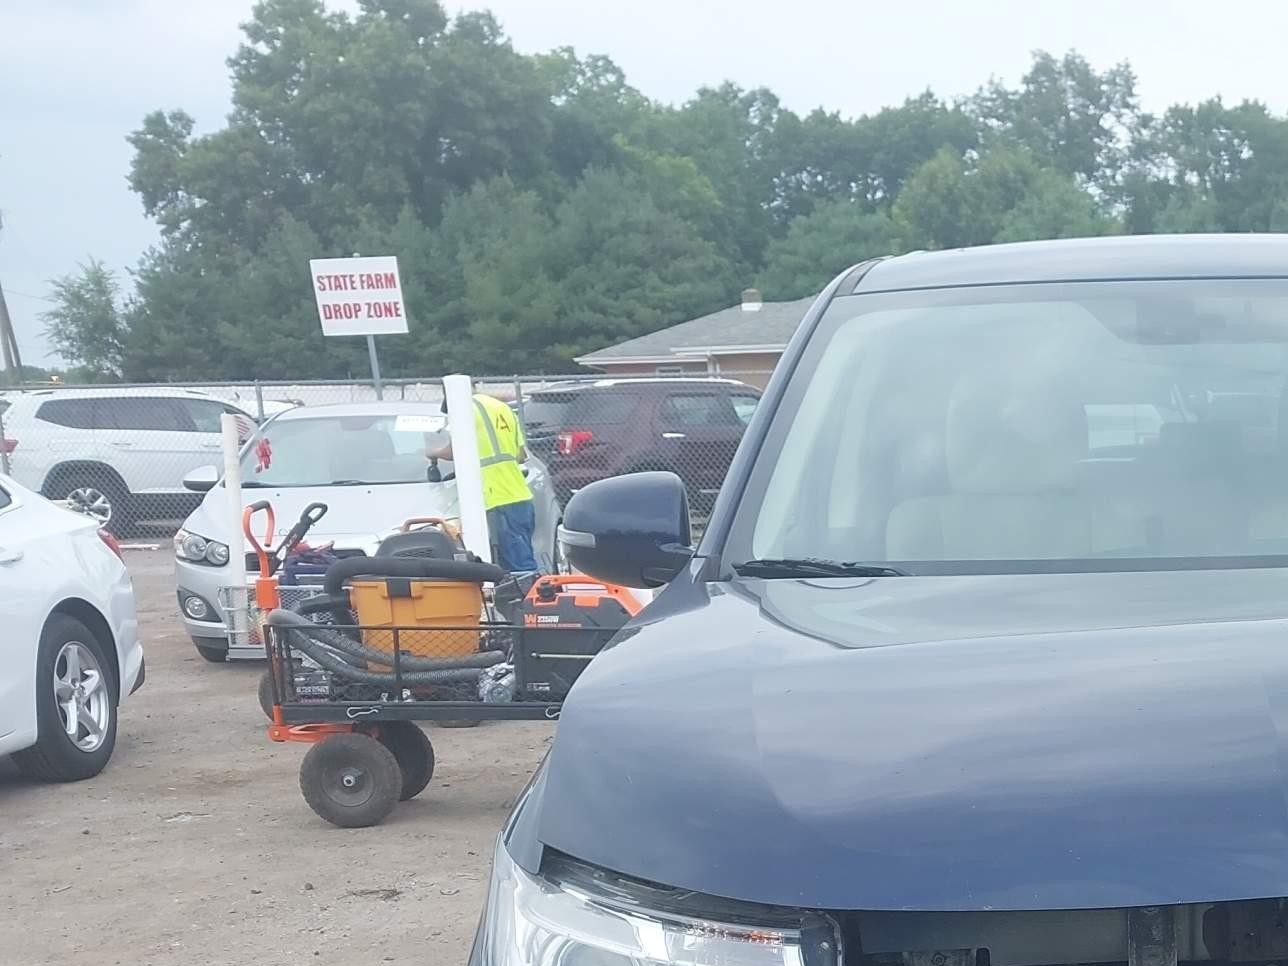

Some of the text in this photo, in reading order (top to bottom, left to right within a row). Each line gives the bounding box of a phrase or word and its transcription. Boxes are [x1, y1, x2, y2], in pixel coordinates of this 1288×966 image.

[316, 272, 396, 291] STATE FARM
[322, 301, 402, 320] DROP ZONE
